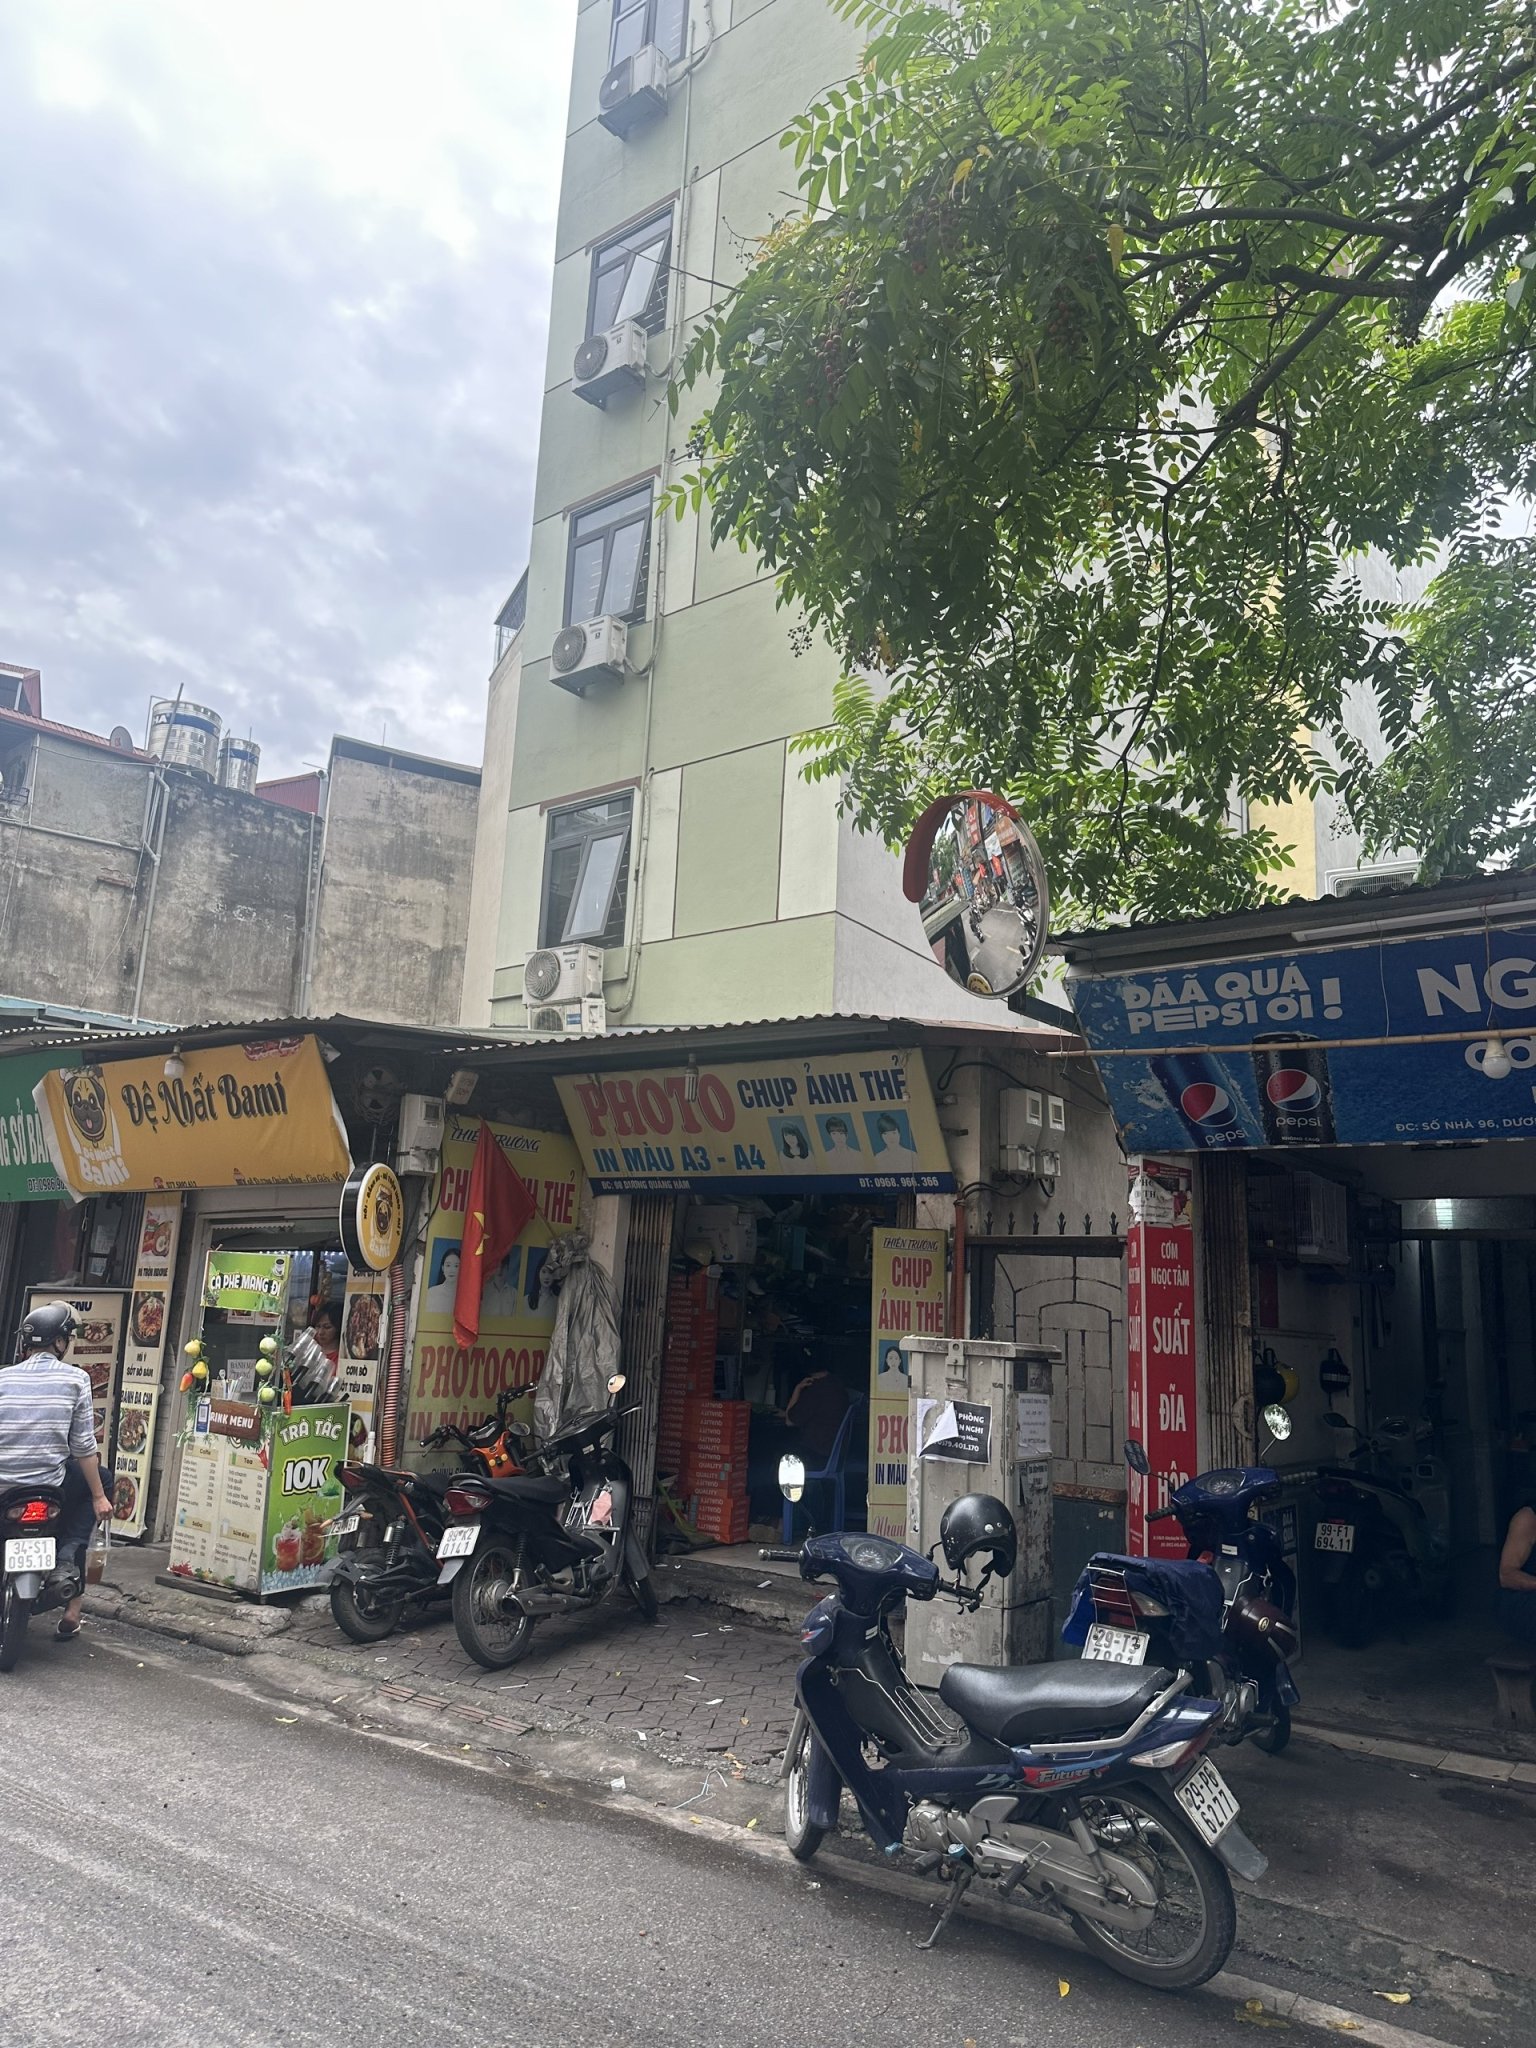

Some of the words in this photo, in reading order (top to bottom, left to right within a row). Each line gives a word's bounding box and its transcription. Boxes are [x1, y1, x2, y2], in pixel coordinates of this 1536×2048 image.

[1214, 961, 1310, 1000] QUÁ
[1128, 1000, 1258, 1034] PEPSI
[574, 1073, 736, 1137] PHOTO
[736, 1077, 798, 1114] CHỤP
[803, 1062, 859, 1105] ẢNH
[1275, 1116, 1321, 1128] pepsi
[1445, 1117, 1475, 1130] NHÀ
[1503, 1116, 1536, 1127] DƯƠ
[451, 1127, 480, 1142] THIÊ
[1205, 1128, 1249, 1146] pepsi
[592, 1147, 620, 1172] IN
[621, 1141, 675, 1173] MÀU
[680, 1145, 712, 1172] A3
[733, 1144, 766, 1171] A4
[1161, 1239, 1178, 1260] CƠM
[241, 1275, 269, 1293] MANG
[891, 1255, 933, 1296] CHỤP
[1151, 1267, 1172, 1290] NGỌC
[1173, 1264, 1190, 1287] TÂM
[878, 1287, 911, 1331] ẢNH
[916, 1291, 944, 1333] THẺ
[1152, 1301, 1191, 1355] SUẤT
[416, 1345, 548, 1399] PHOTOCOP
[958, 1411, 985, 1424] PHÒNG
[1159, 1383, 1187, 1432] ĐĨA
[228, 1414, 254, 1430] MENU
[279, 1419, 309, 1443] TRÀ
[284, 1458, 330, 1491] 10K
[875, 1463, 885, 1485] IN
[1321, 1524, 1349, 1538] 99-F1
[14, 1541, 48, 1555] 34-S1
[1316, 1536, 1351, 1551] 694.11
[8, 1554, 52, 1569] 095.18
[1094, 1628, 1141, 1655] 29-T3
[1200, 1788, 1234, 1834] 6277
